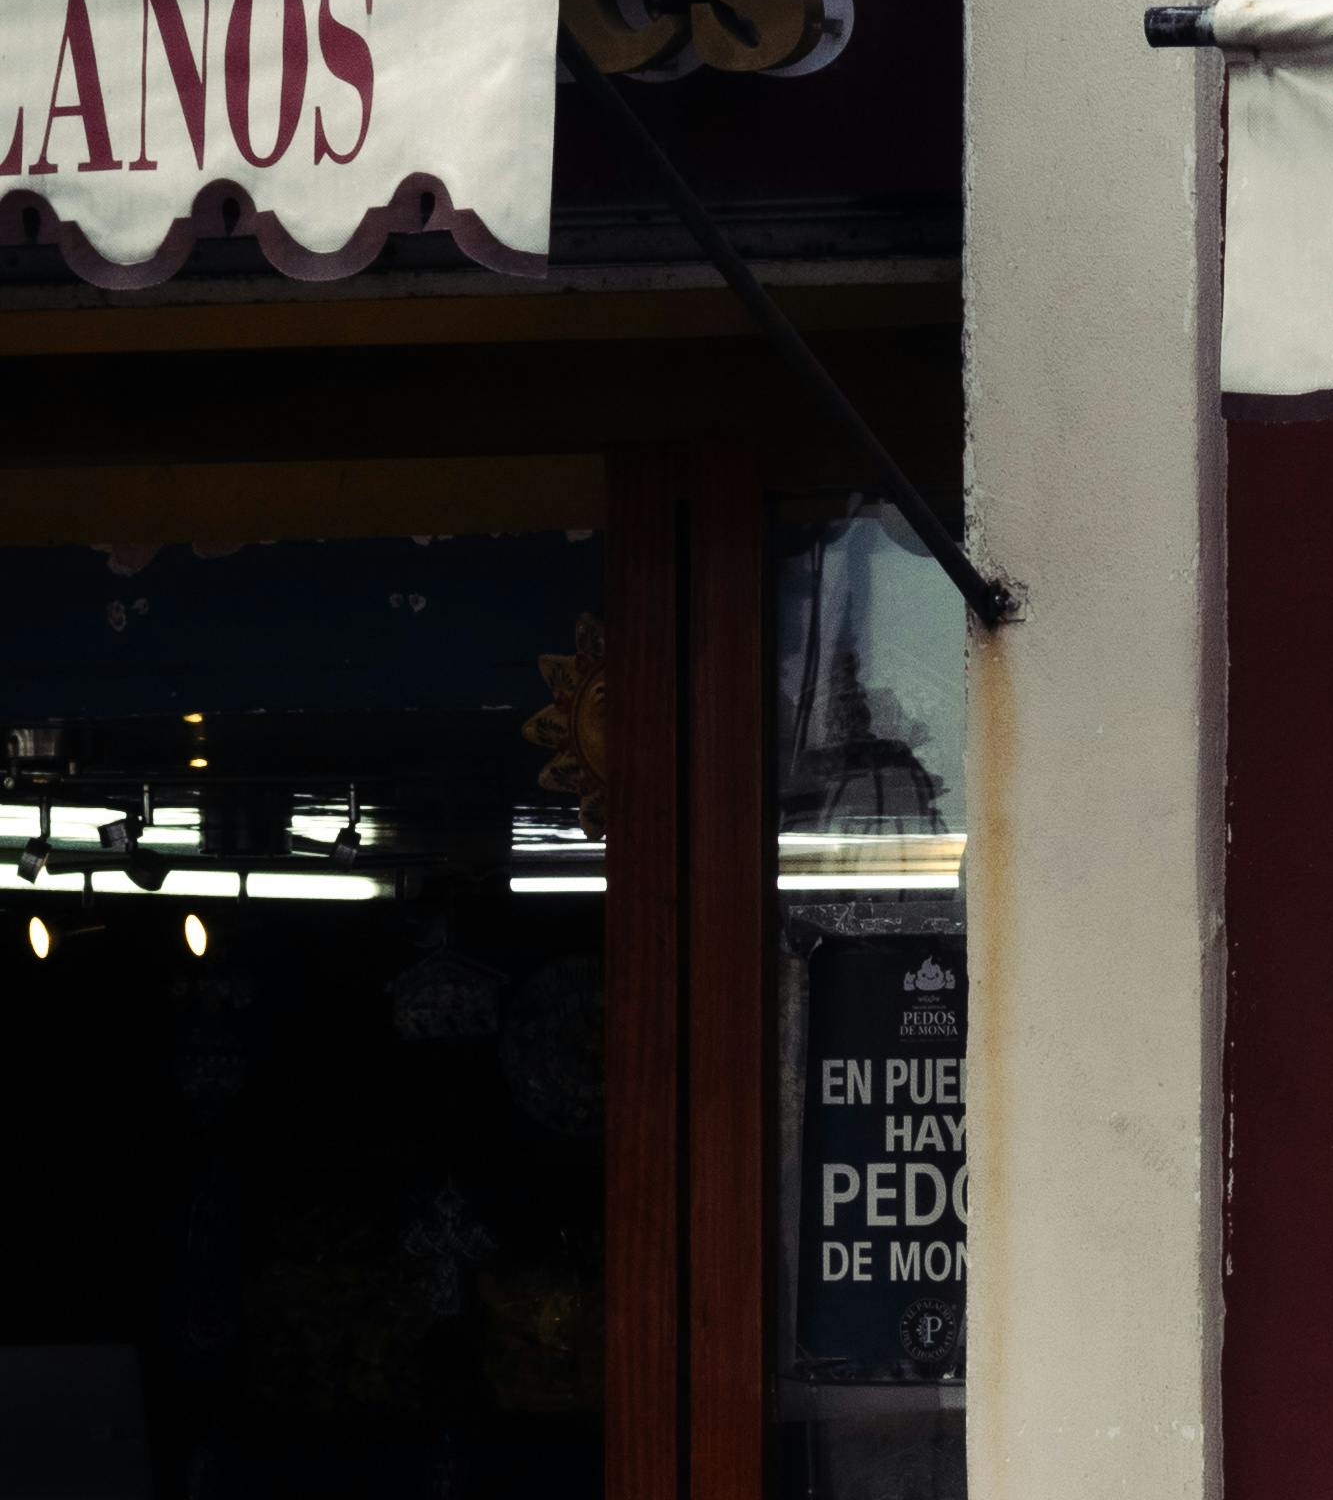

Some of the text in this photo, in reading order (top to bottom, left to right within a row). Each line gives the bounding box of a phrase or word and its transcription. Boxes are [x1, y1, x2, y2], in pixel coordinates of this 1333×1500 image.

[899, 1025, 959, 1037] DE MONJA
[903, 1011, 956, 1026] PEDOS
[822, 1058, 966, 1105] EN PUE
[885, 1114, 966, 1152] HAY
[822, 1241, 872, 1282] DE
